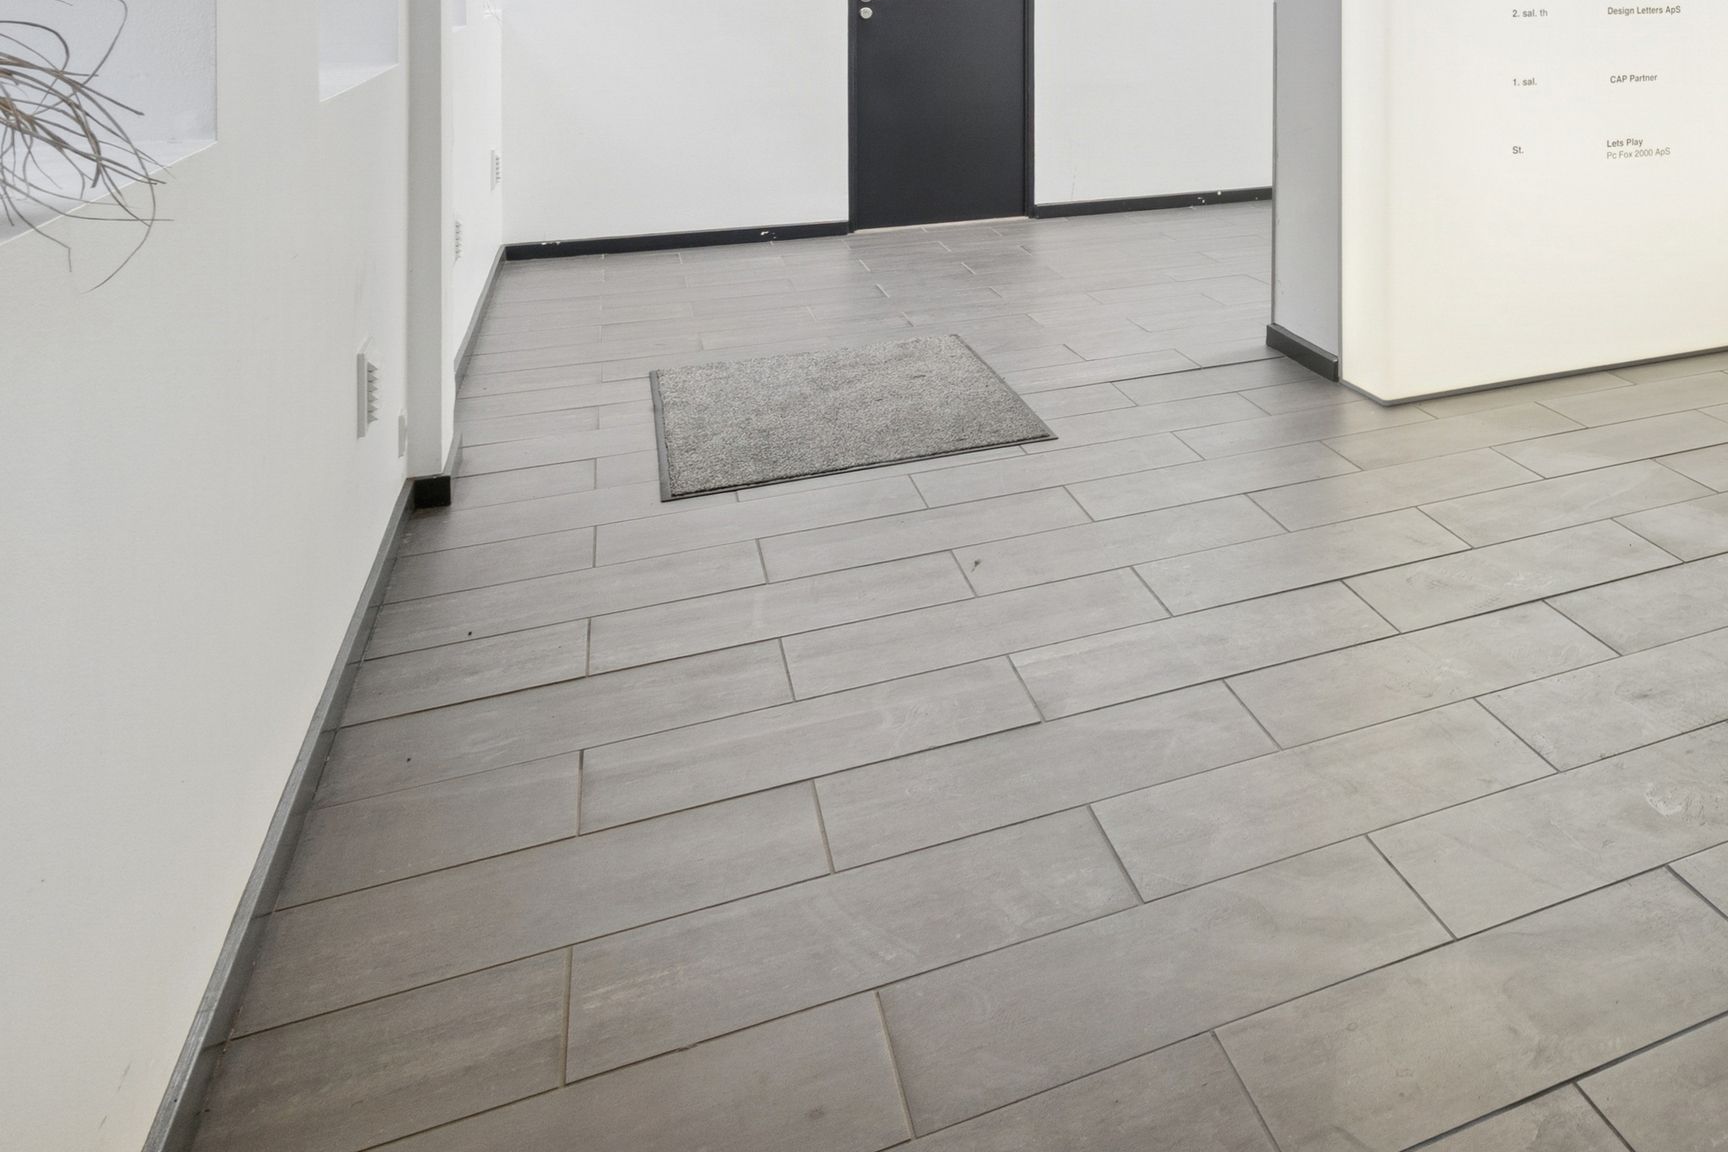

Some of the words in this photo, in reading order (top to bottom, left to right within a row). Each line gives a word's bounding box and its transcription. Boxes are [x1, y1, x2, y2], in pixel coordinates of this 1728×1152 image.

[1512, 9, 1520, 18] 2.
[1522, 9, 1537, 17] sal.
[1608, 7, 1635, 16] Design
[1636, 6, 1663, 14] Letters
[1666, 6, 1681, 15] ApS
[1513, 78, 1520, 86] 1.
[1522, 78, 1537, 86] sal.
[1610, 75, 1628, 83] CAP
[1630, 74, 1658, 82] Partner
[1606, 139, 1624, 148] Lets
[1626, 138, 1643, 147] Play
[1512, 146, 1524, 154] St.
[1606, 151, 1617, 159] Pc
[1619, 150, 1632, 158] Fox
[1635, 149, 1653, 157] 2000
[1655, 147, 1671, 157] ApS
